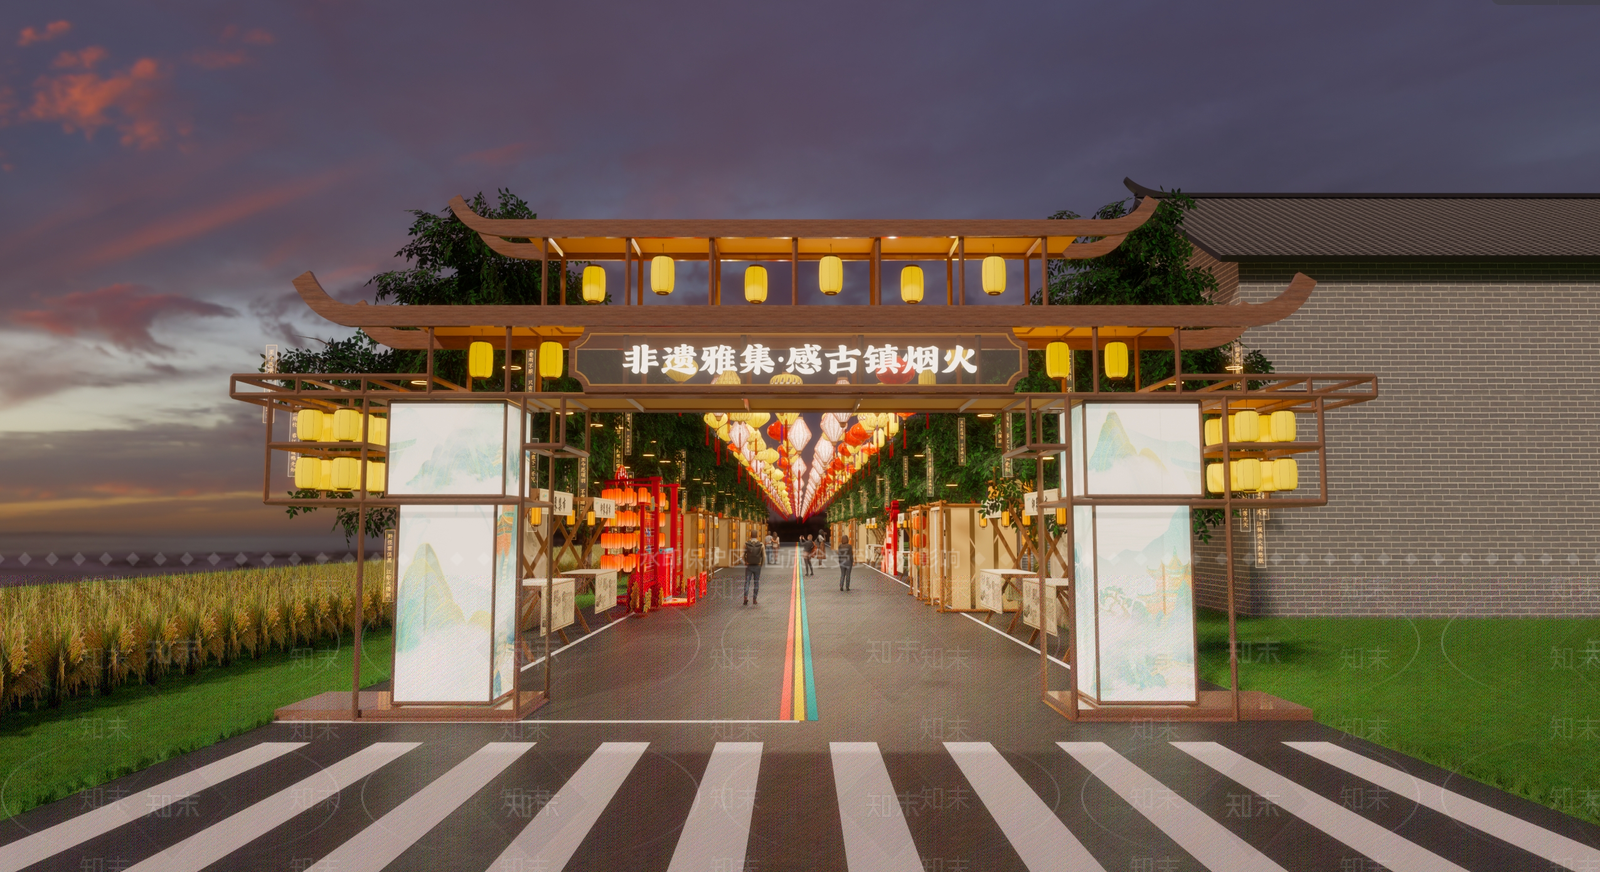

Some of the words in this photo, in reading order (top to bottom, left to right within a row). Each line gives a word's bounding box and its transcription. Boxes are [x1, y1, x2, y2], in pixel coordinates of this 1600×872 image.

[622, 343, 978, 375] 非遗雅集·感古镇烟火
